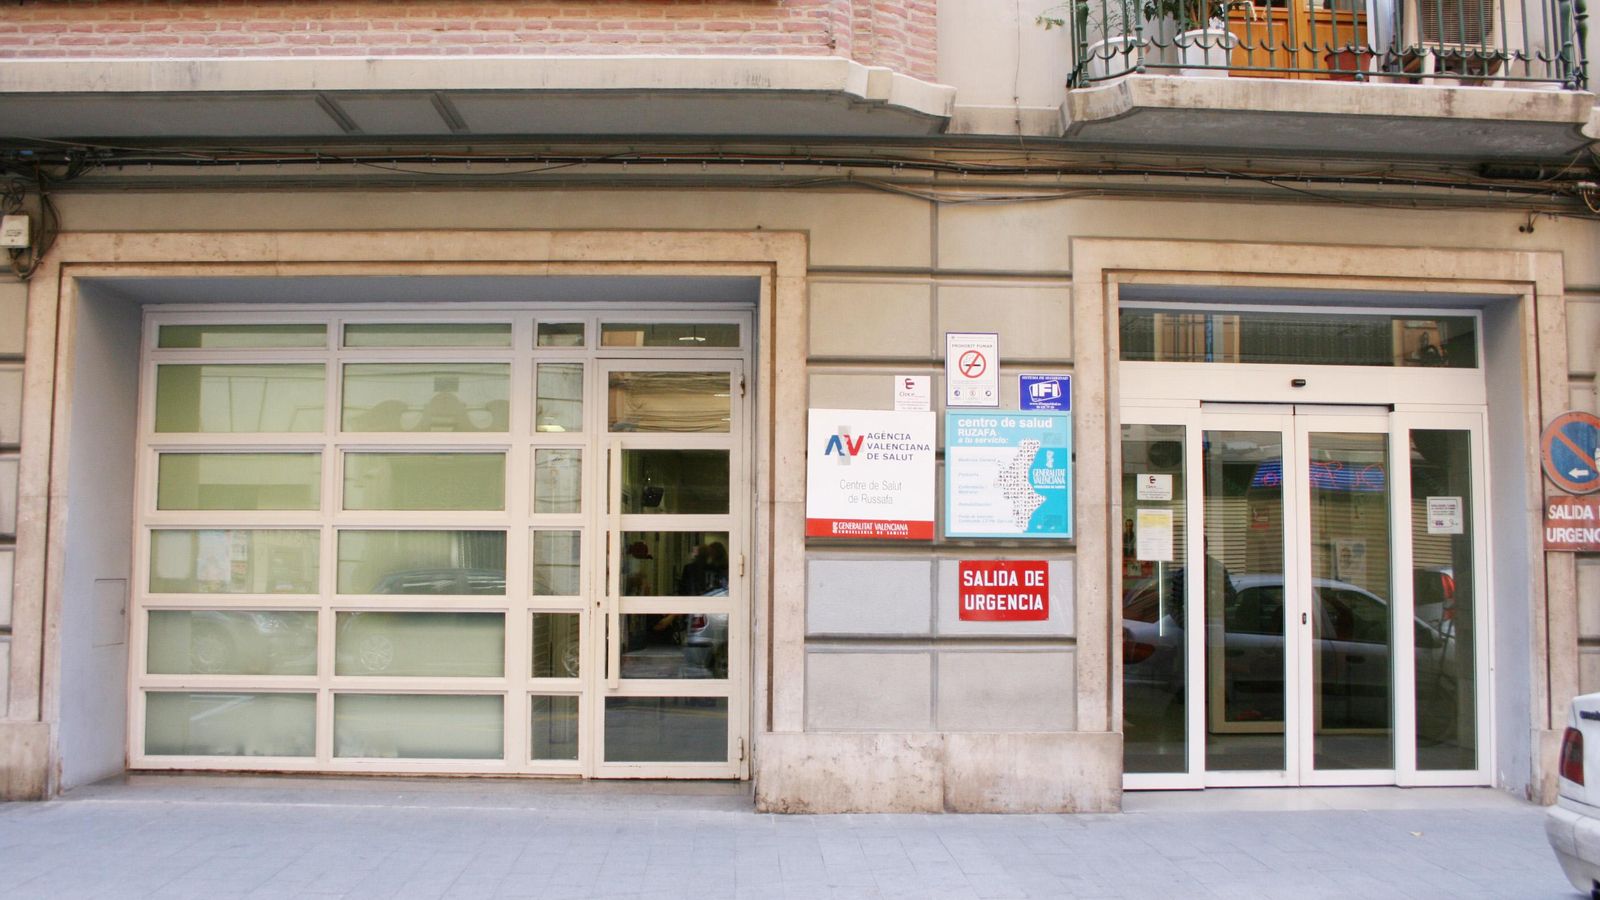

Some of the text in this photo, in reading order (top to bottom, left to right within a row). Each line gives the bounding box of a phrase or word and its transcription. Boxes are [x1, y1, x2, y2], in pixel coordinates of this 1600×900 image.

[1032, 383, 1058, 397] IFI
[958, 417, 1053, 428] centro de salud
[958, 428, 997, 437] RUZAFA
[867, 443, 930, 451] VALENCIANA
[882, 453, 914, 461] SALUT
[840, 480, 902, 491] Centre de Salut
[848, 494, 893, 504] de Russafa
[1548, 504, 1594, 520] SALIDA
[838, 522, 908, 531] GENERALITAT VALENCIANA
[964, 570, 1044, 586] SALIDA DE
[964, 594, 1044, 610] URGENCIA
